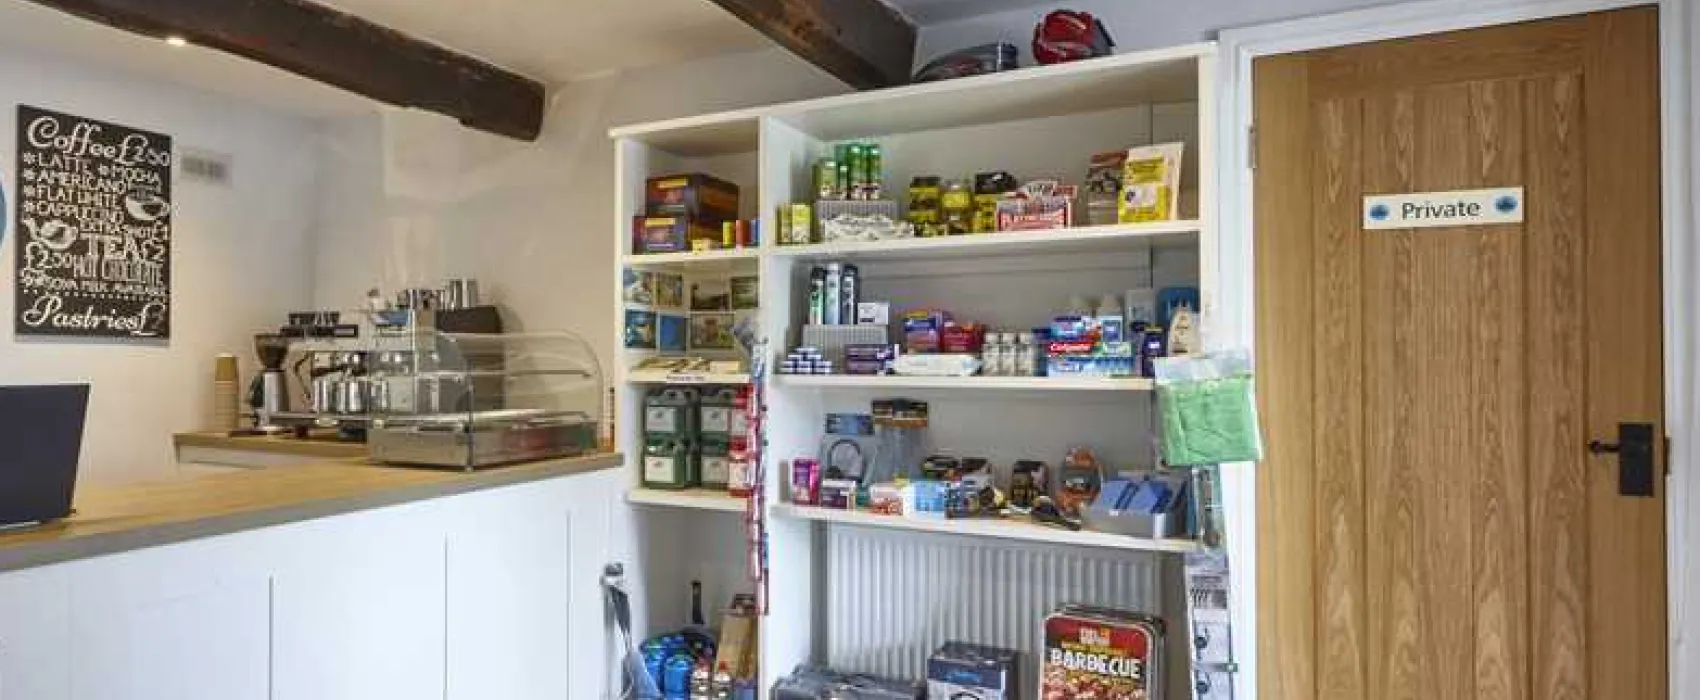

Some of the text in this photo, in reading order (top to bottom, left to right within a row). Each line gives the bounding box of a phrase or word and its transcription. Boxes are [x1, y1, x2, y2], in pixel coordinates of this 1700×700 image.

[27, 116, 115, 157] Coffee
[37, 170, 127, 195] AMERICANO
[38, 152, 161, 183] LATTE MOCHA
[37, 185, 74, 203] FLAT
[1401, 200, 1482, 220] Private
[80, 232, 141, 262] TEA
[23, 295, 140, 328] Pastries
[1051, 647, 1141, 679] BARBECUE
